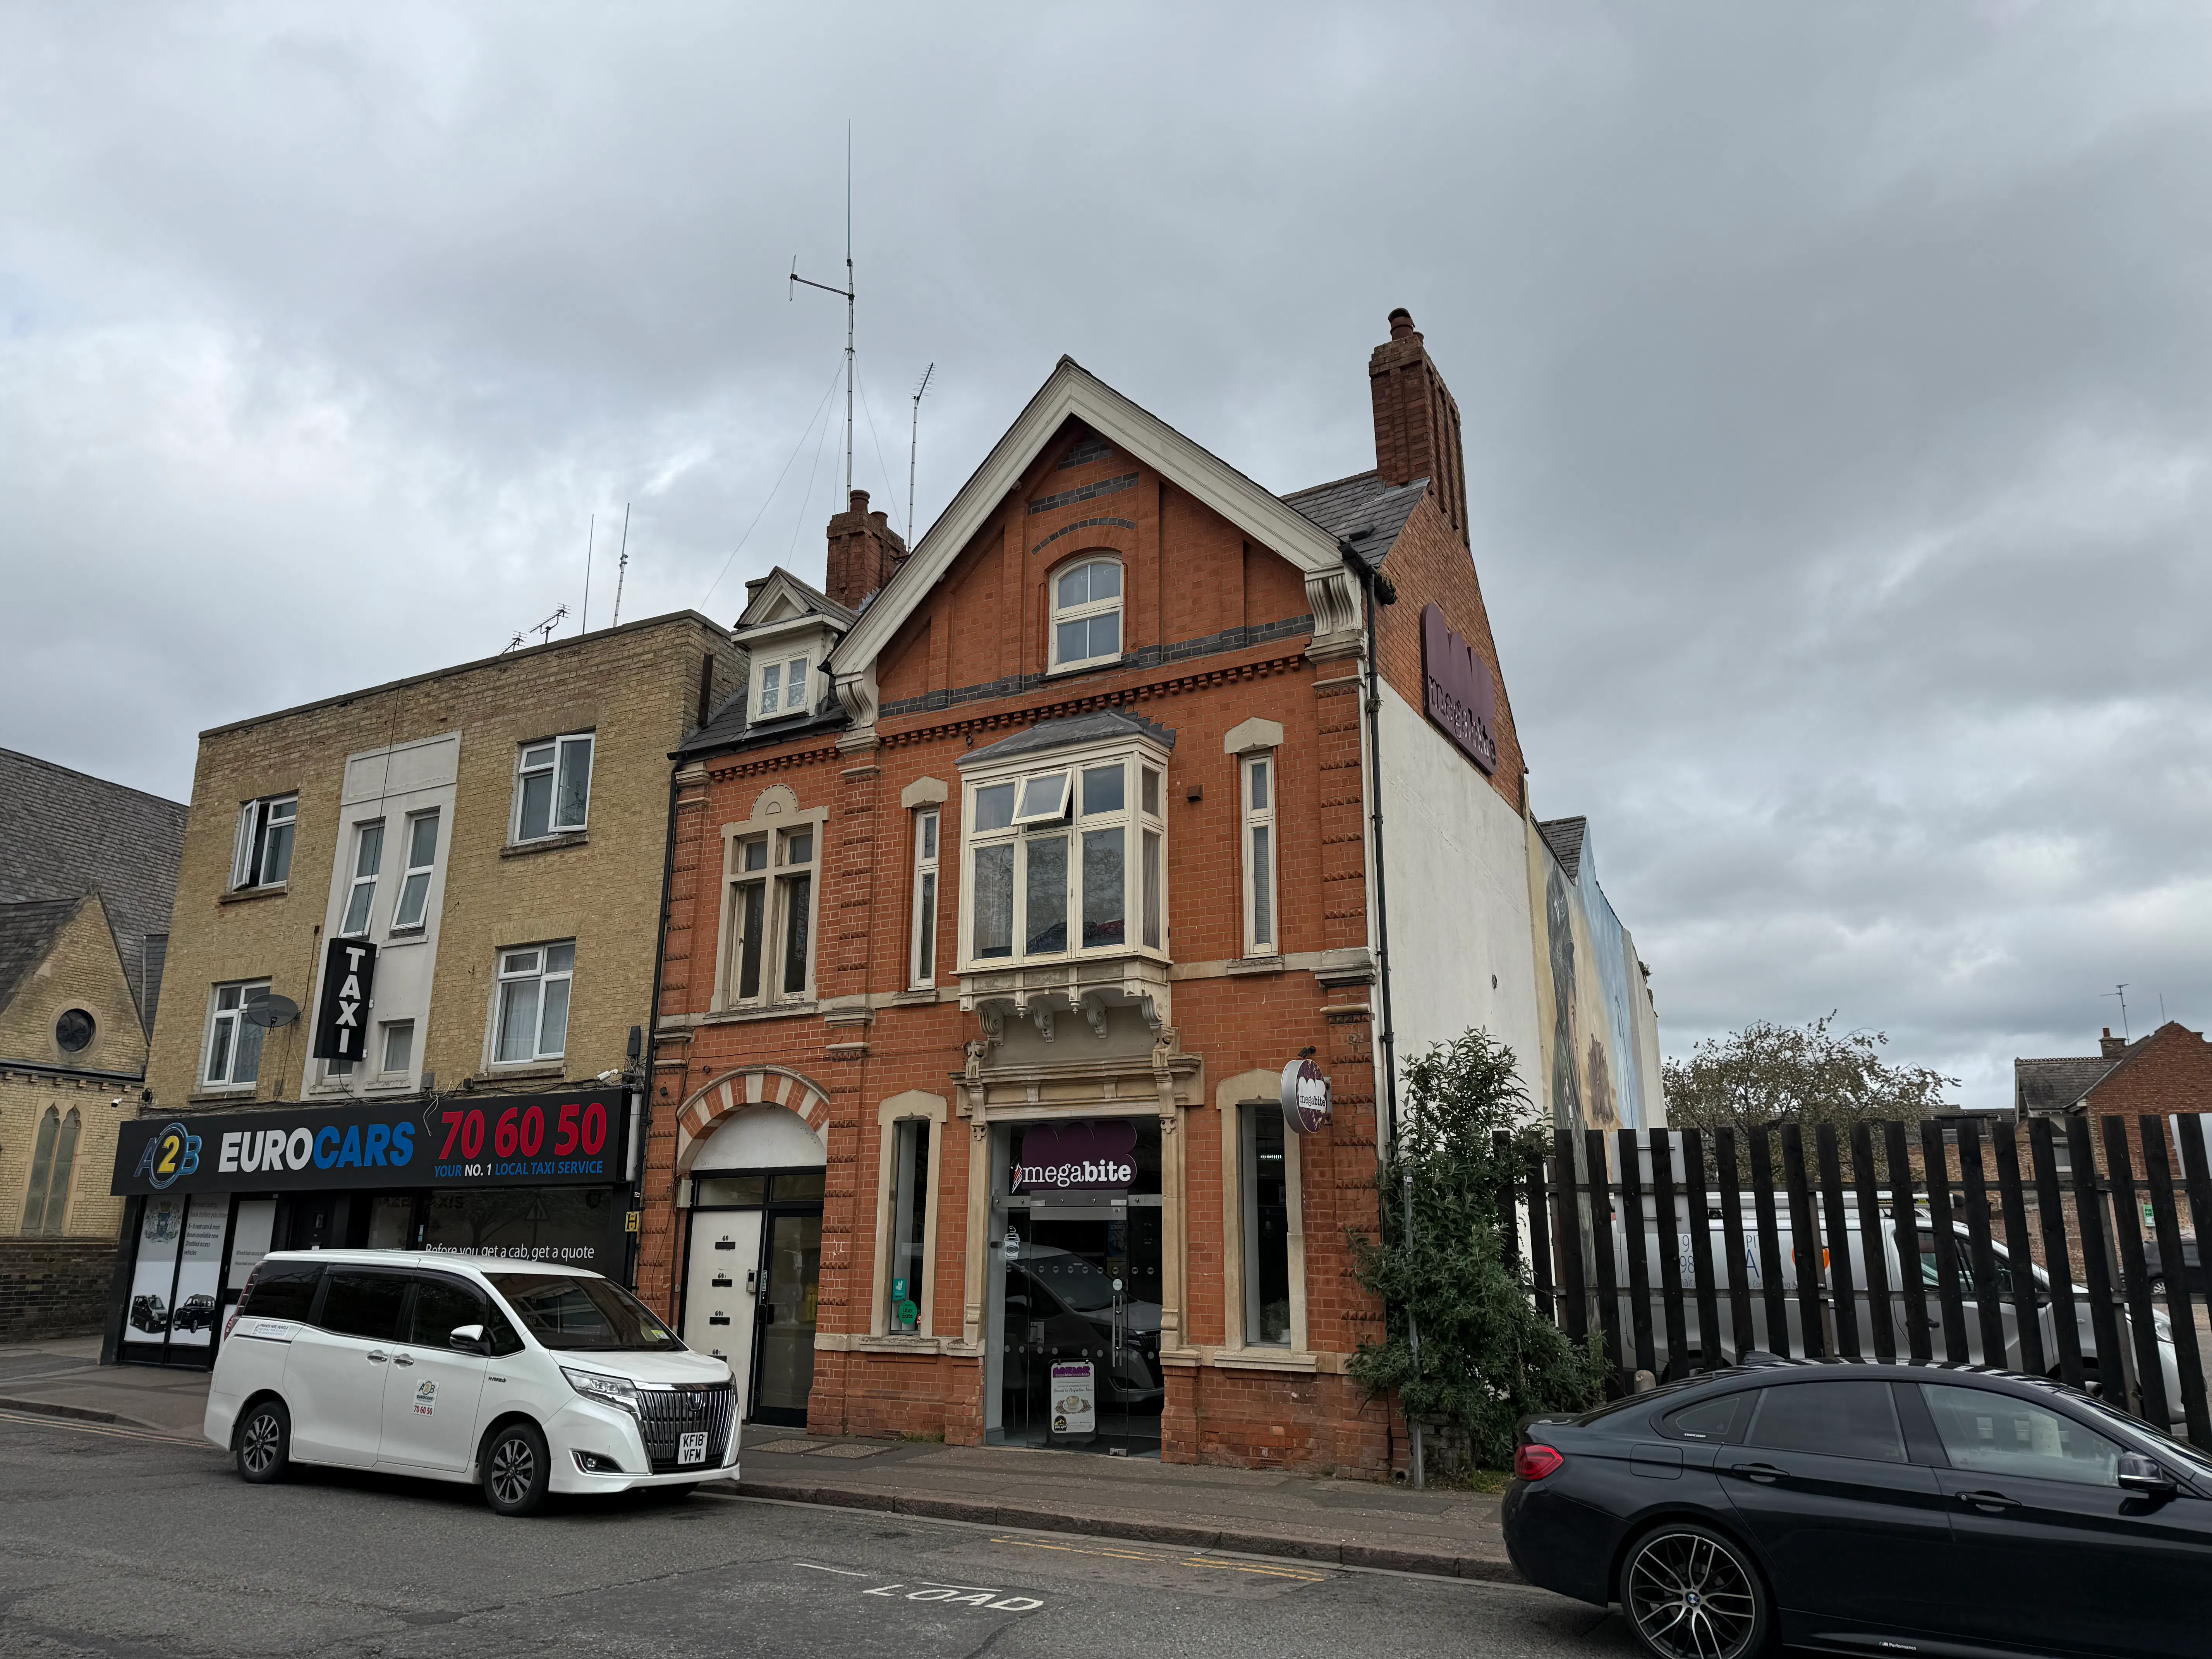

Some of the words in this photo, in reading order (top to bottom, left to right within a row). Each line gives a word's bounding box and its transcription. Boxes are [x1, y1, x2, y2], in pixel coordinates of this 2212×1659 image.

[1429, 675, 1496, 766] megabite
[335, 946, 366, 1053] TAXI
[1300, 1095, 1326, 1107] megabite
[439, 1109, 485, 1160] 70
[495, 1106, 544, 1157] 60
[555, 1103, 606, 1156] 50
[134, 1126, 202, 1186] A2B
[218, 1122, 415, 1172] EUROCARS
[434, 1165, 462, 1177] YOUR
[464, 1164, 483, 1176] NO.
[487, 1163, 492, 1176] 1
[495, 1163, 528, 1175] LOCAL
[531, 1161, 555, 1175] TAXI
[557, 1161, 603, 1174] SERVICE
[1023, 1159, 1131, 1187] megabite
[426, 1243, 457, 1253] Before
[460, 1247, 478, 1255] you
[482, 1245, 498, 1257] get
[500, 1247, 507, 1258] a
[532, 1245, 550, 1262] get
[552, 1247, 558, 1258] a
[561, 1245, 595, 1262] quote
[419, 1381, 435, 1395] A2B
[683, 1432, 703, 1447] KF18
[684, 1448, 701, 1462] VFM
[862, 1584, 1044, 1611] LOAD
